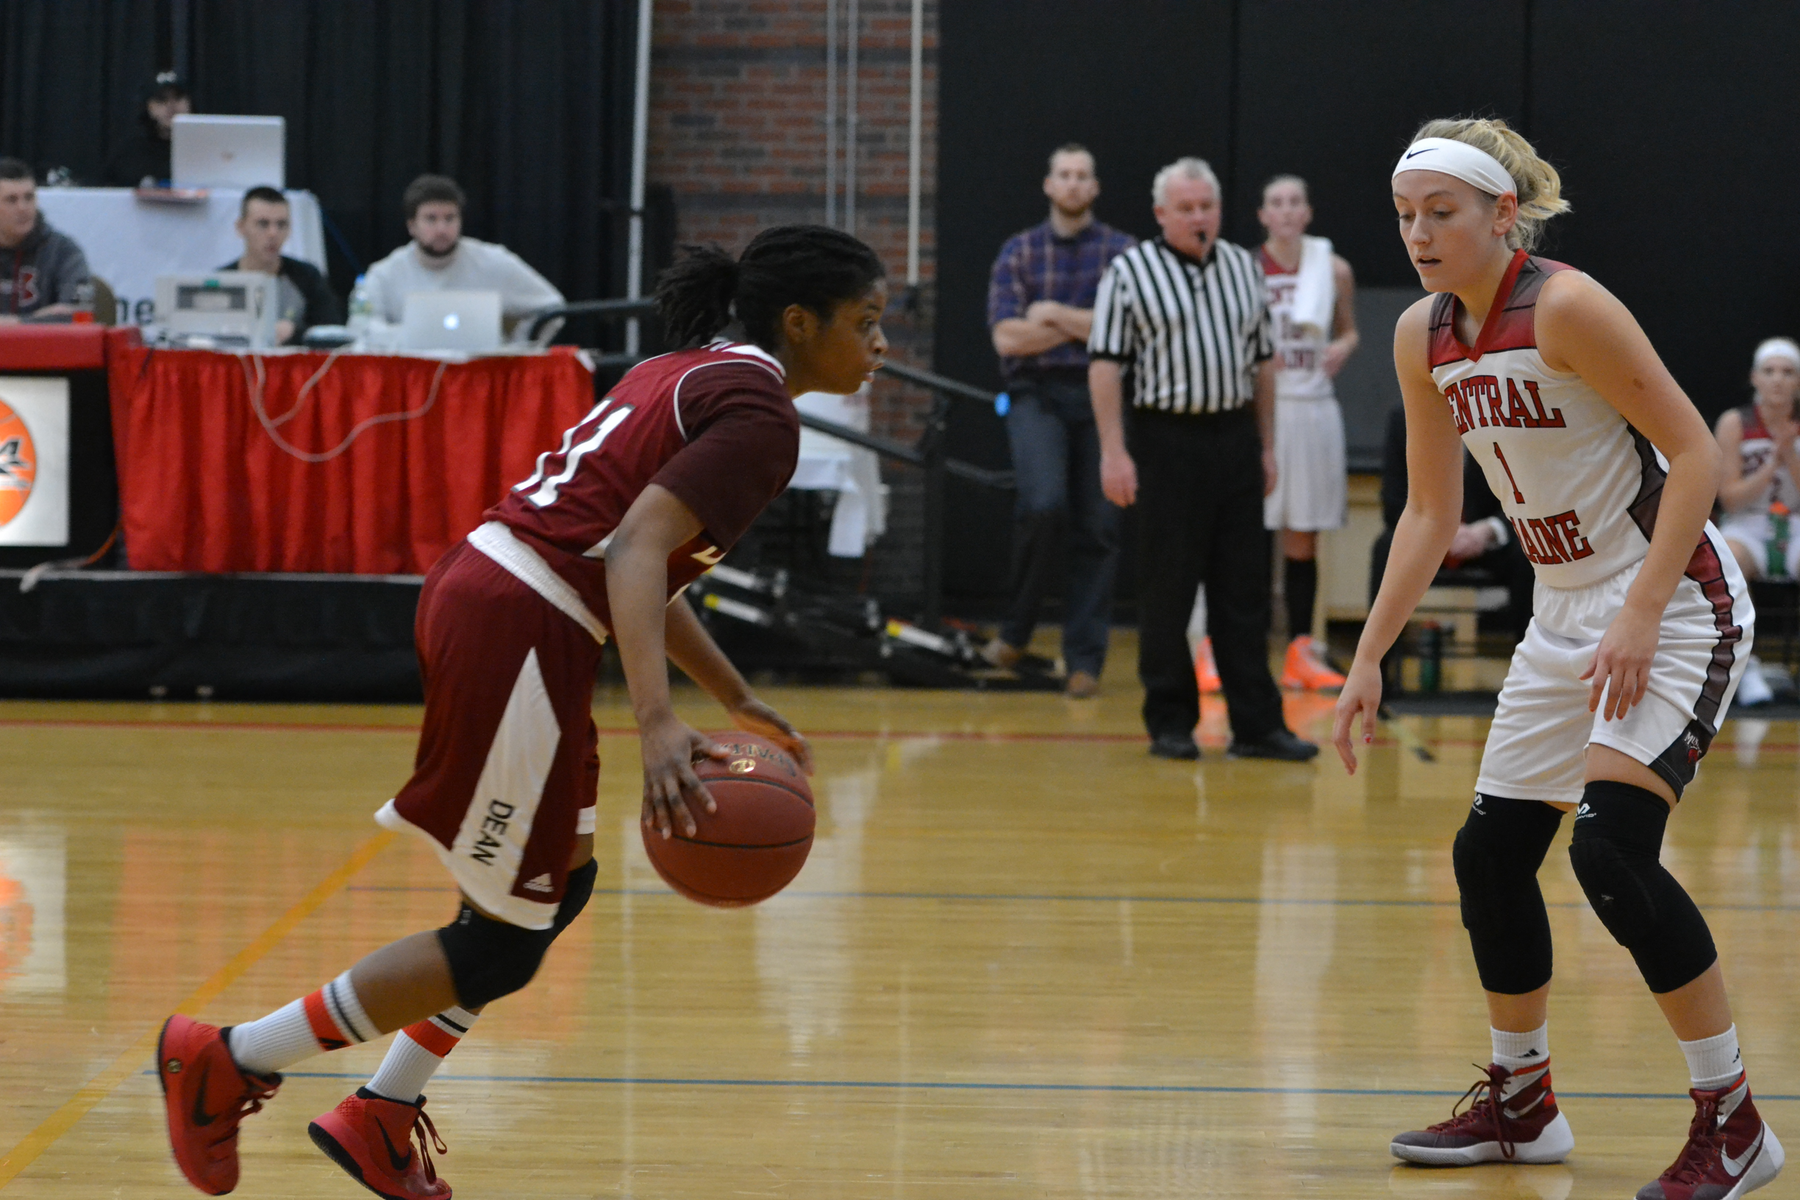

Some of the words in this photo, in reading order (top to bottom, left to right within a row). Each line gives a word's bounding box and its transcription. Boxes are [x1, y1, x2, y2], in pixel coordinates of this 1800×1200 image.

[1444, 375, 1566, 436] ENTRAL
[1493, 442, 1525, 504] 1
[470, 799, 516, 867] DEAN
